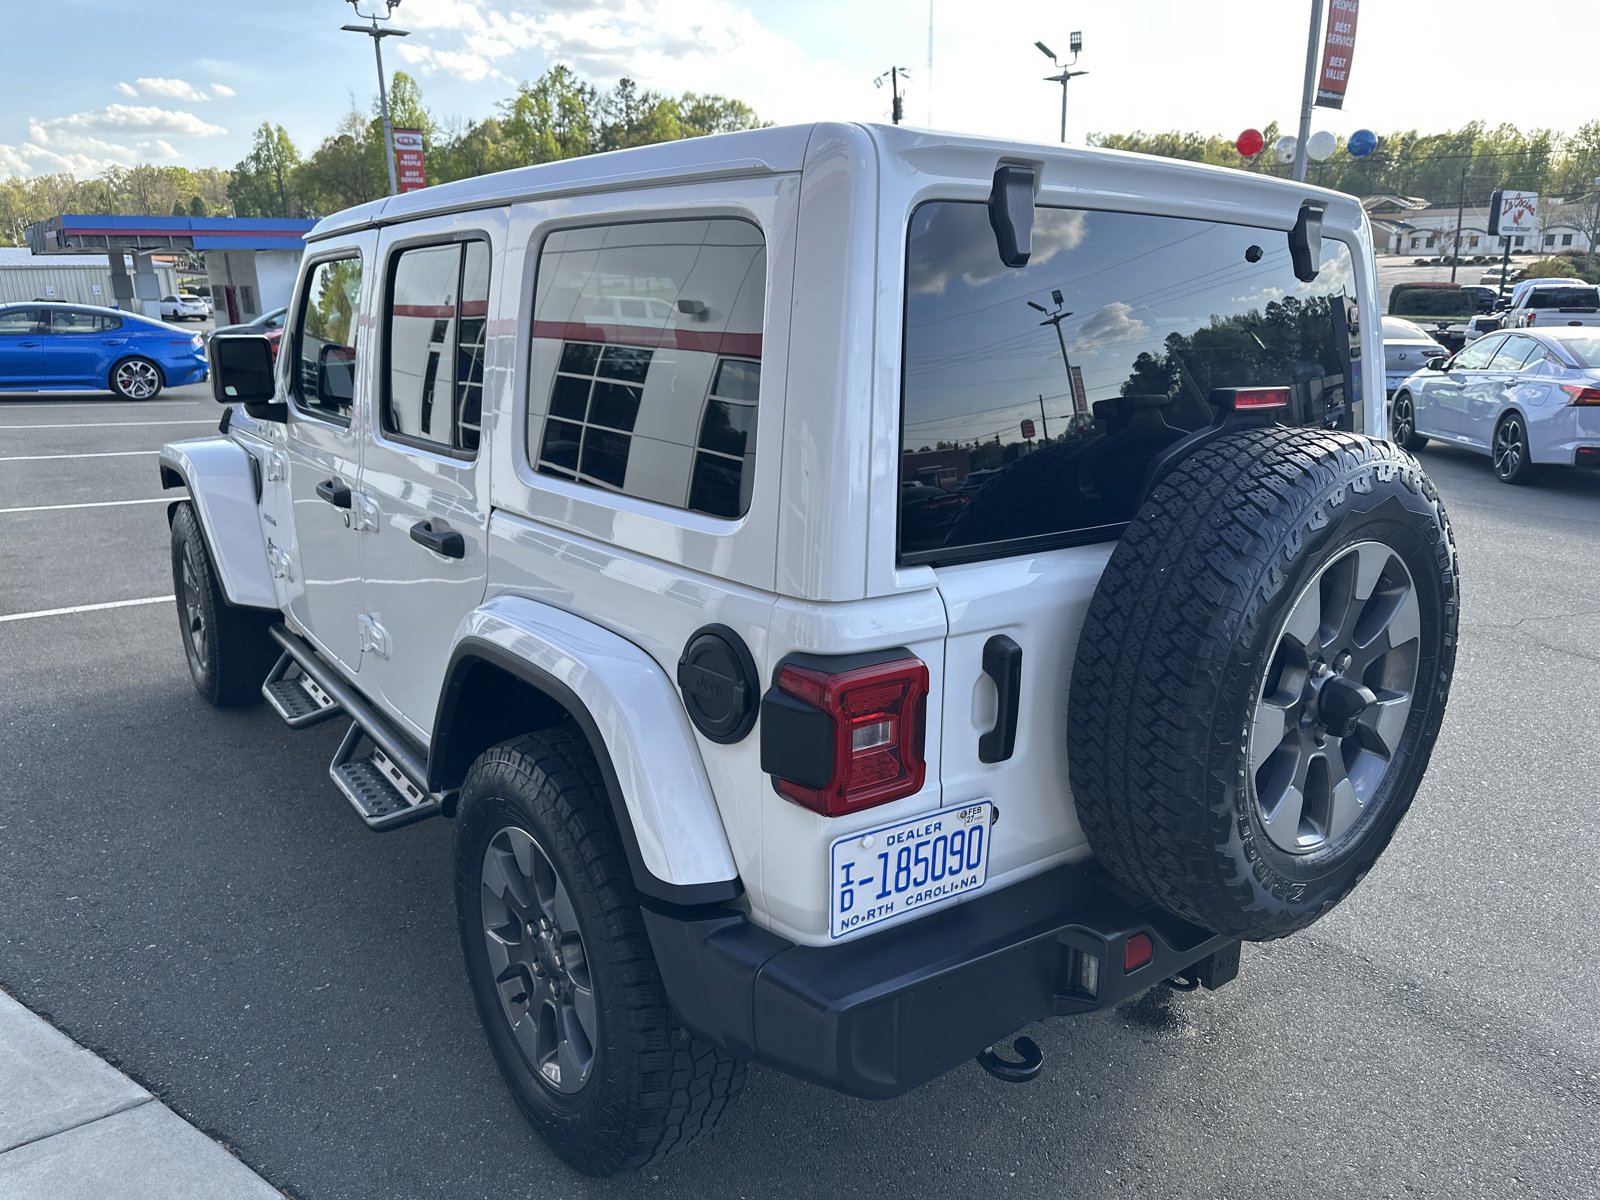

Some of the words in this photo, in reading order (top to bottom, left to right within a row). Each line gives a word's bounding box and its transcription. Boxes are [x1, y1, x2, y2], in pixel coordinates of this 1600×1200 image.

[1332, 0, 1357, 12] PEOPLE
[1334, 22, 1351, 33] BEST
[1327, 34, 1354, 47] SERVICE
[1329, 57, 1346, 68] BEST
[1325, 69, 1345, 81] VALUE
[1515, 192, 1535, 216] Cocina
[968, 805, 982, 816] FEB
[966, 815, 975, 824] 27
[886, 821, 942, 847] DEALER
[840, 901, 894, 931] NORTH
[905, 874, 977, 906] CAROLINA
